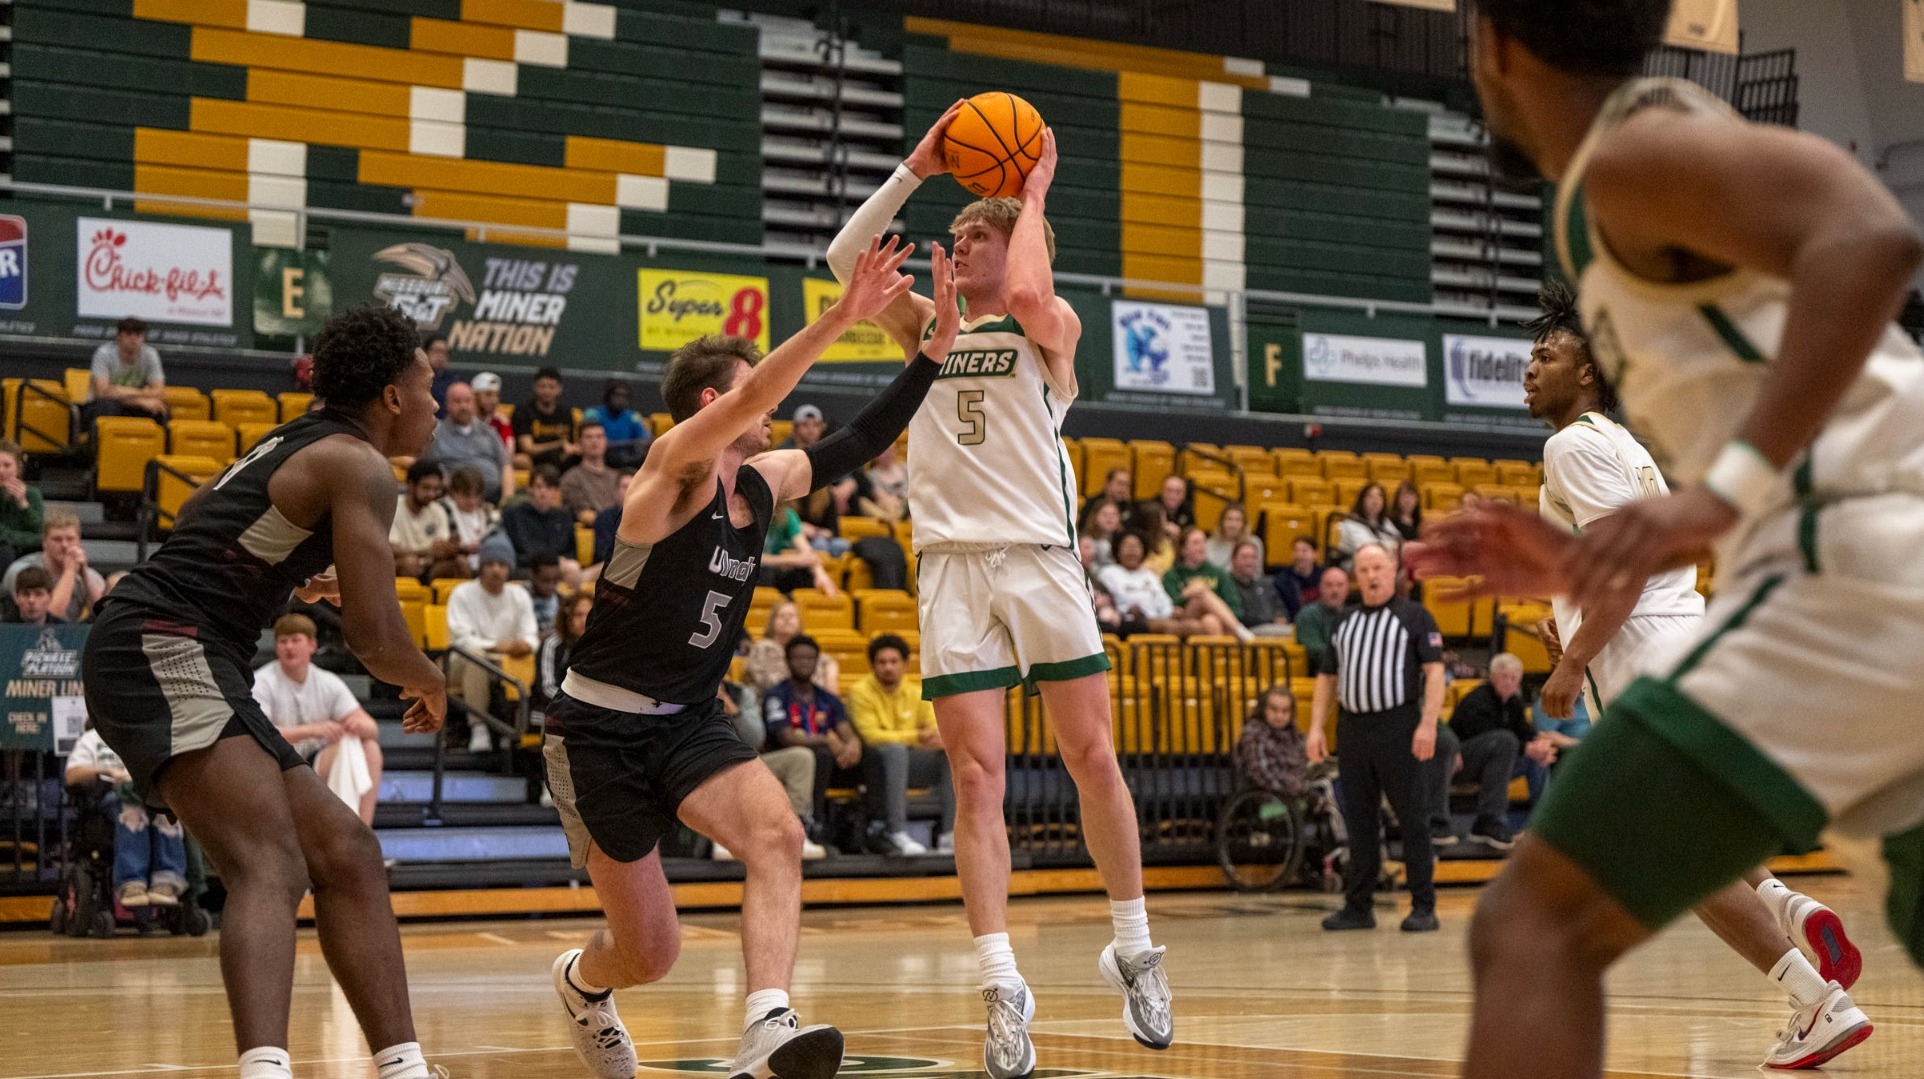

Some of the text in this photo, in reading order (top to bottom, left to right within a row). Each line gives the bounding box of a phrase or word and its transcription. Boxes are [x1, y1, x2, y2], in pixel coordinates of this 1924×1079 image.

[86, 243, 224, 301] Chick-fil-A
[282, 267, 304, 318] E
[483, 257, 578, 293] THIS IS
[474, 290, 567, 325] MINER
[647, 280, 723, 322] Super
[723, 286, 763, 341] 8
[448, 320, 555, 357] NATION
[1265, 343, 1282, 387] F
[958, 390, 986, 445] 5
[688, 590, 733, 649] 5
[6, 679, 56, 698] MINER
